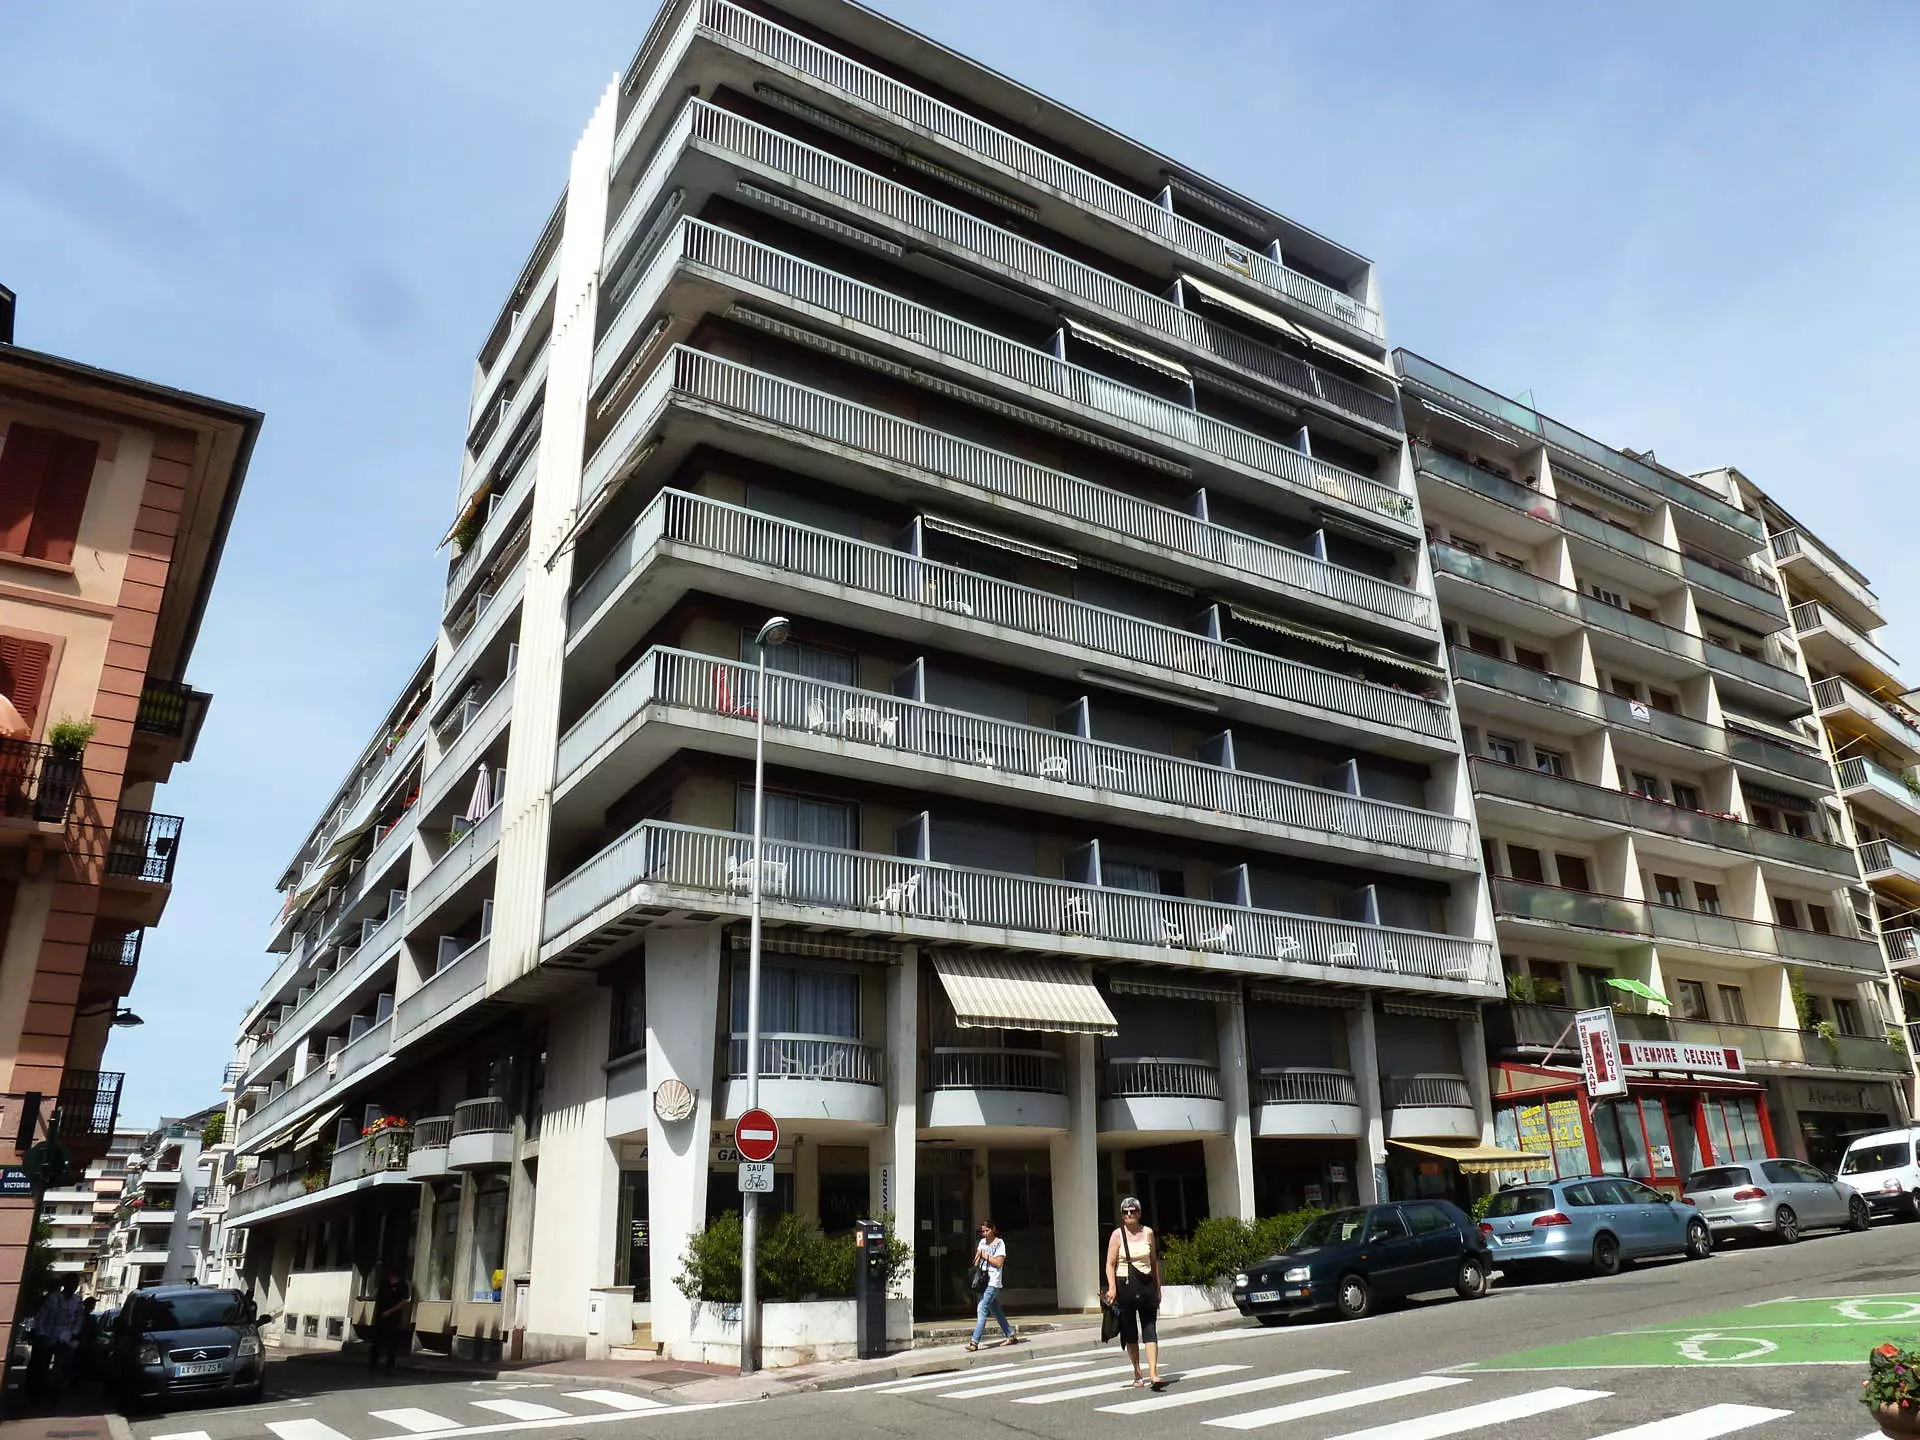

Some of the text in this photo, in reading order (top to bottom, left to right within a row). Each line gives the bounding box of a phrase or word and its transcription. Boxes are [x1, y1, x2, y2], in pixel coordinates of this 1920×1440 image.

[1579, 1025, 1597, 1094] RESTAURANT
[1601, 1030, 1617, 1081] CHINOIS
[1634, 1046, 1723, 1066] L'EMPIRE CELESTE
[746, 1164, 766, 1172] SAUF
